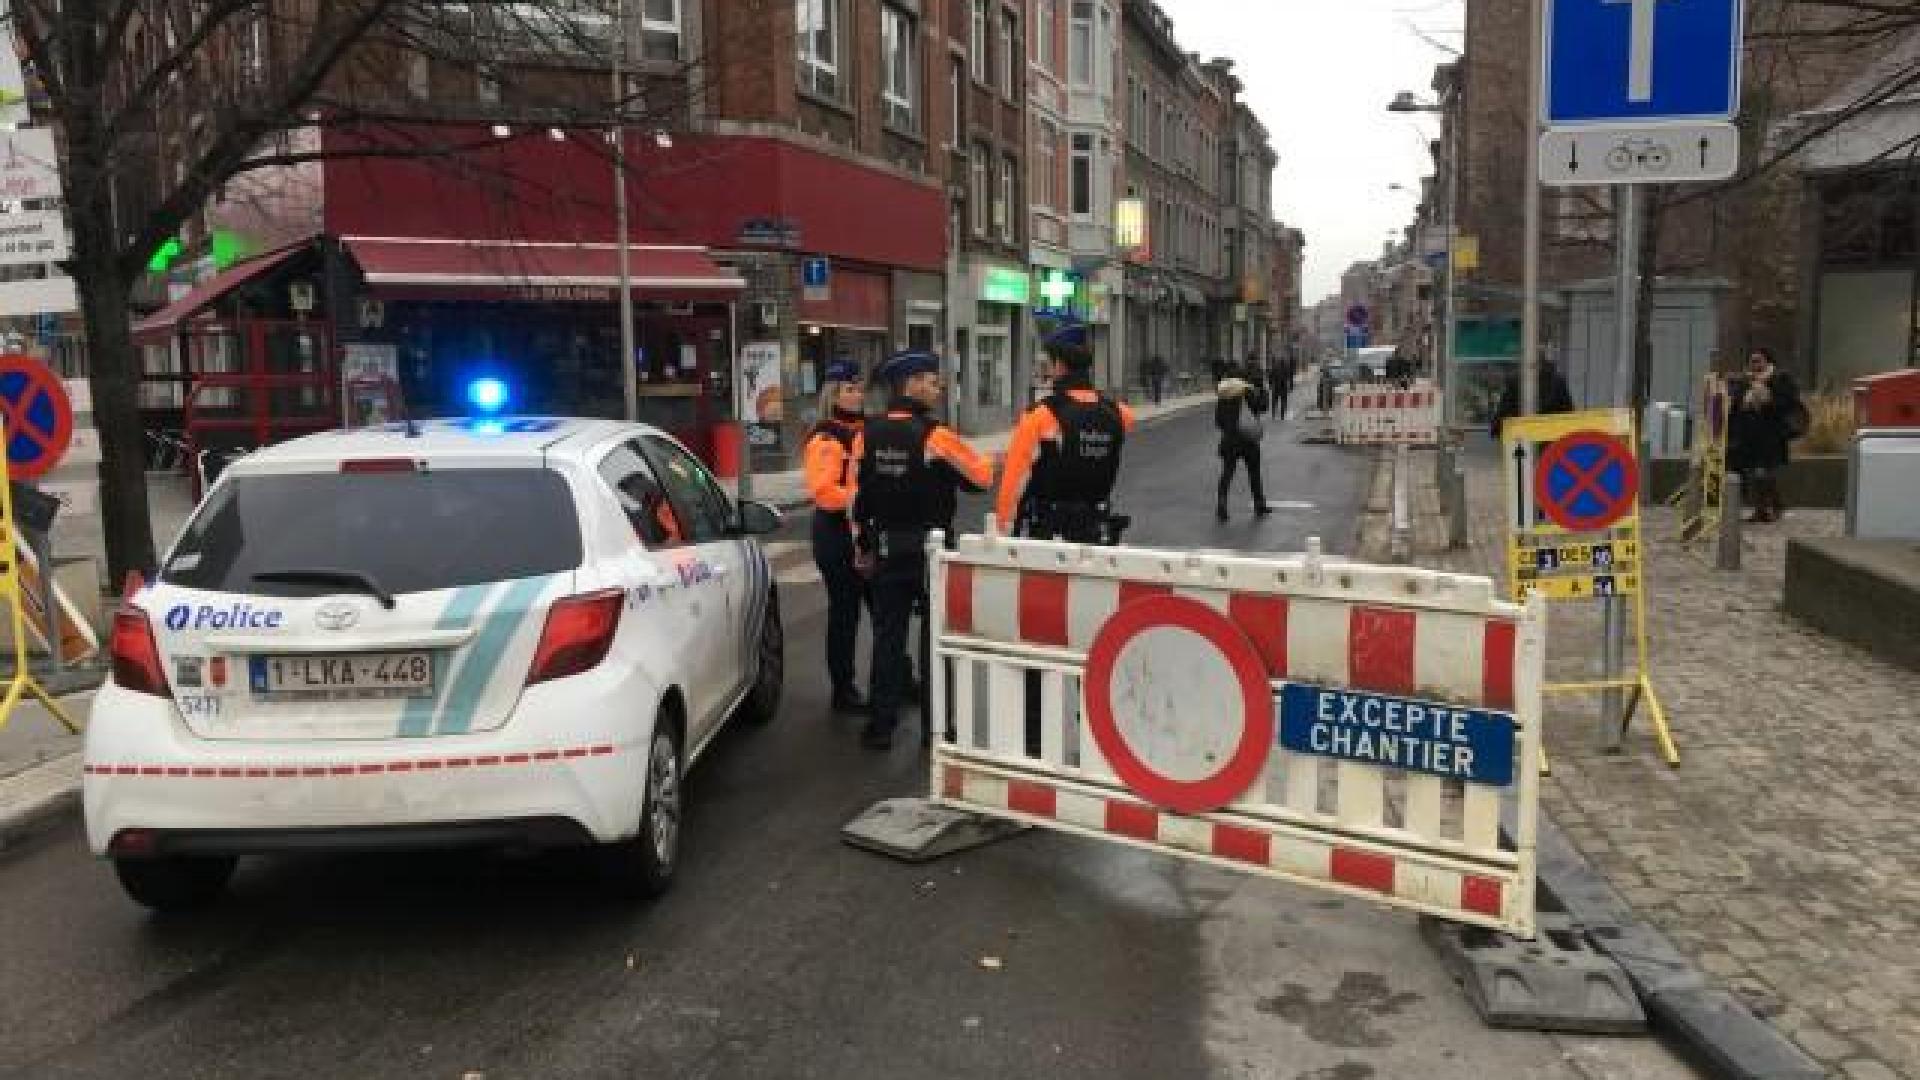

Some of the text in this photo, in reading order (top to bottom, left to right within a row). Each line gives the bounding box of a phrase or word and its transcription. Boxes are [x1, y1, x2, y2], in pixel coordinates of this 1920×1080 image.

[195, 603, 282, 630] Police
[1318, 692, 1470, 742] EXCEPTE
[1310, 722, 1475, 778] CHANTIER
